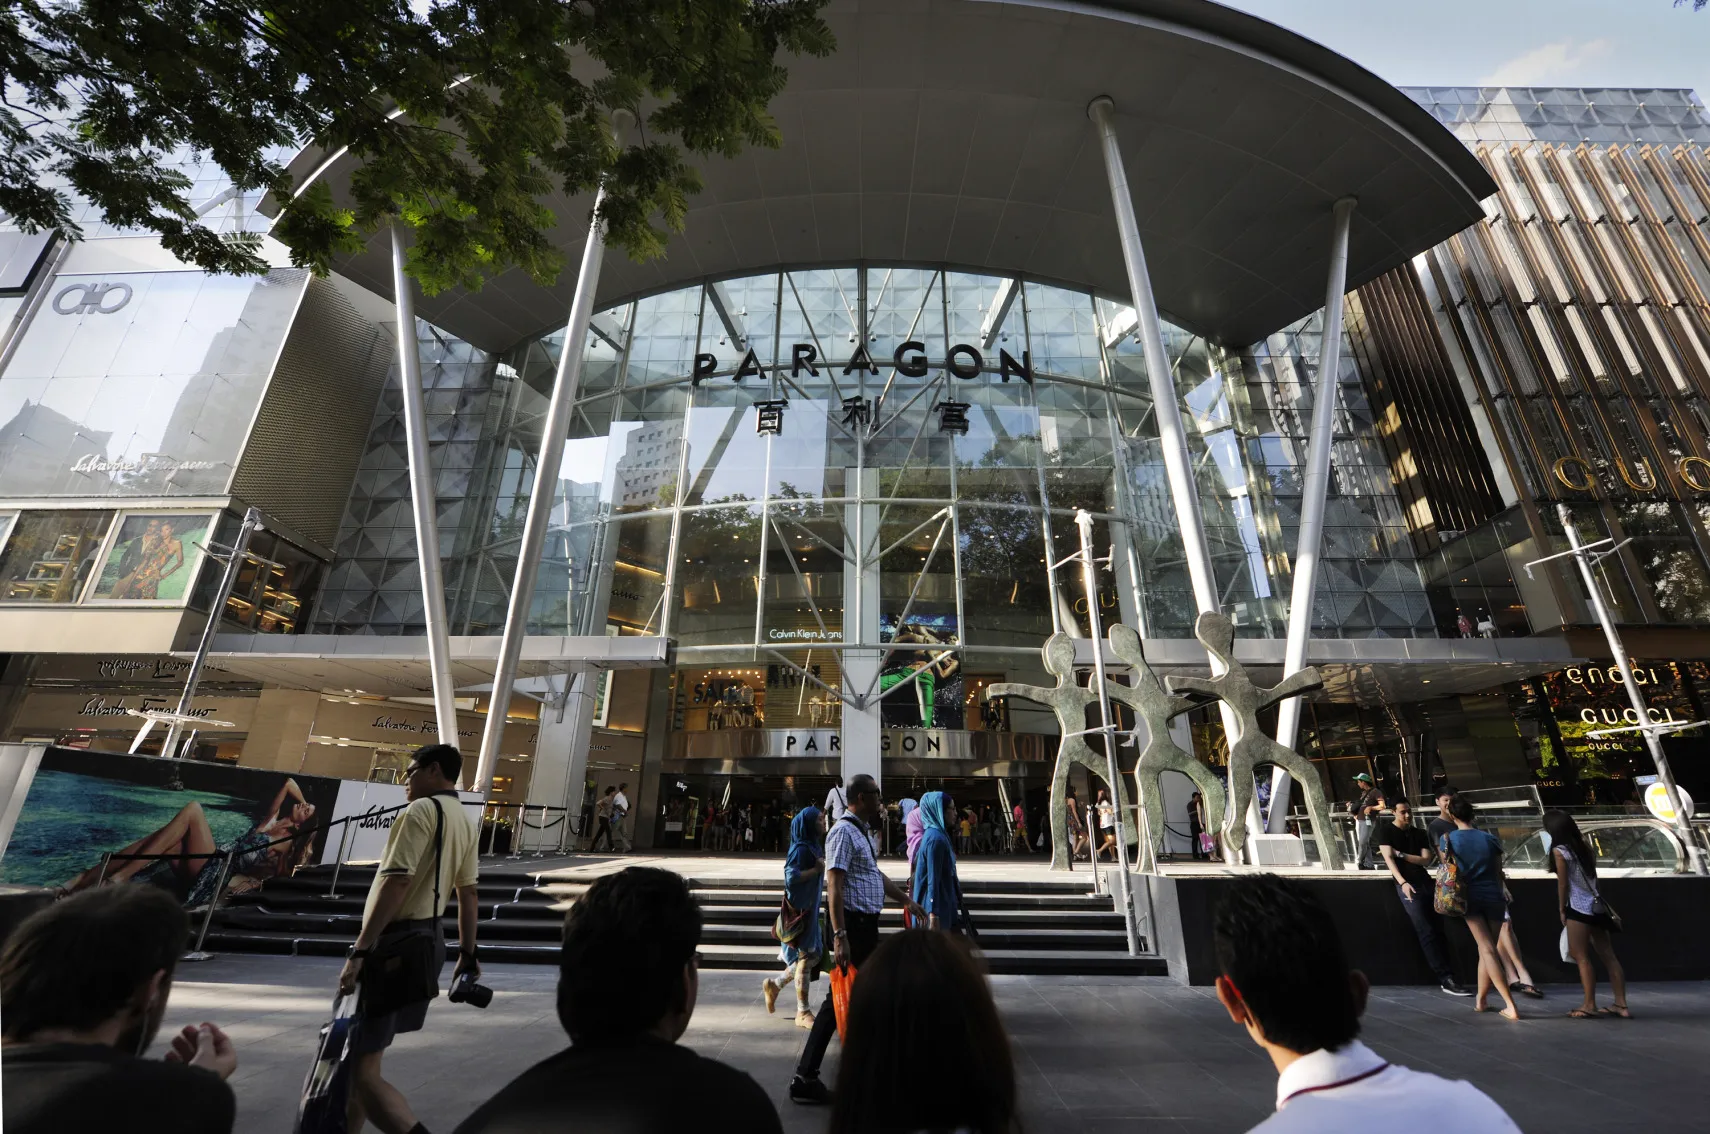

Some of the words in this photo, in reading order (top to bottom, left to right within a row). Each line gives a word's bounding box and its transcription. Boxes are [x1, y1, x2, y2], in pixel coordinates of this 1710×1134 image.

[691, 340, 1033, 386] PARAGON
[769, 628, 796, 639] Calvin
[797, 629, 818, 639] Klein
[372, 715, 417, 732] Salvatore
[1580, 707, 1674, 725] GUCCI
[786, 735, 940, 752] PARGON
